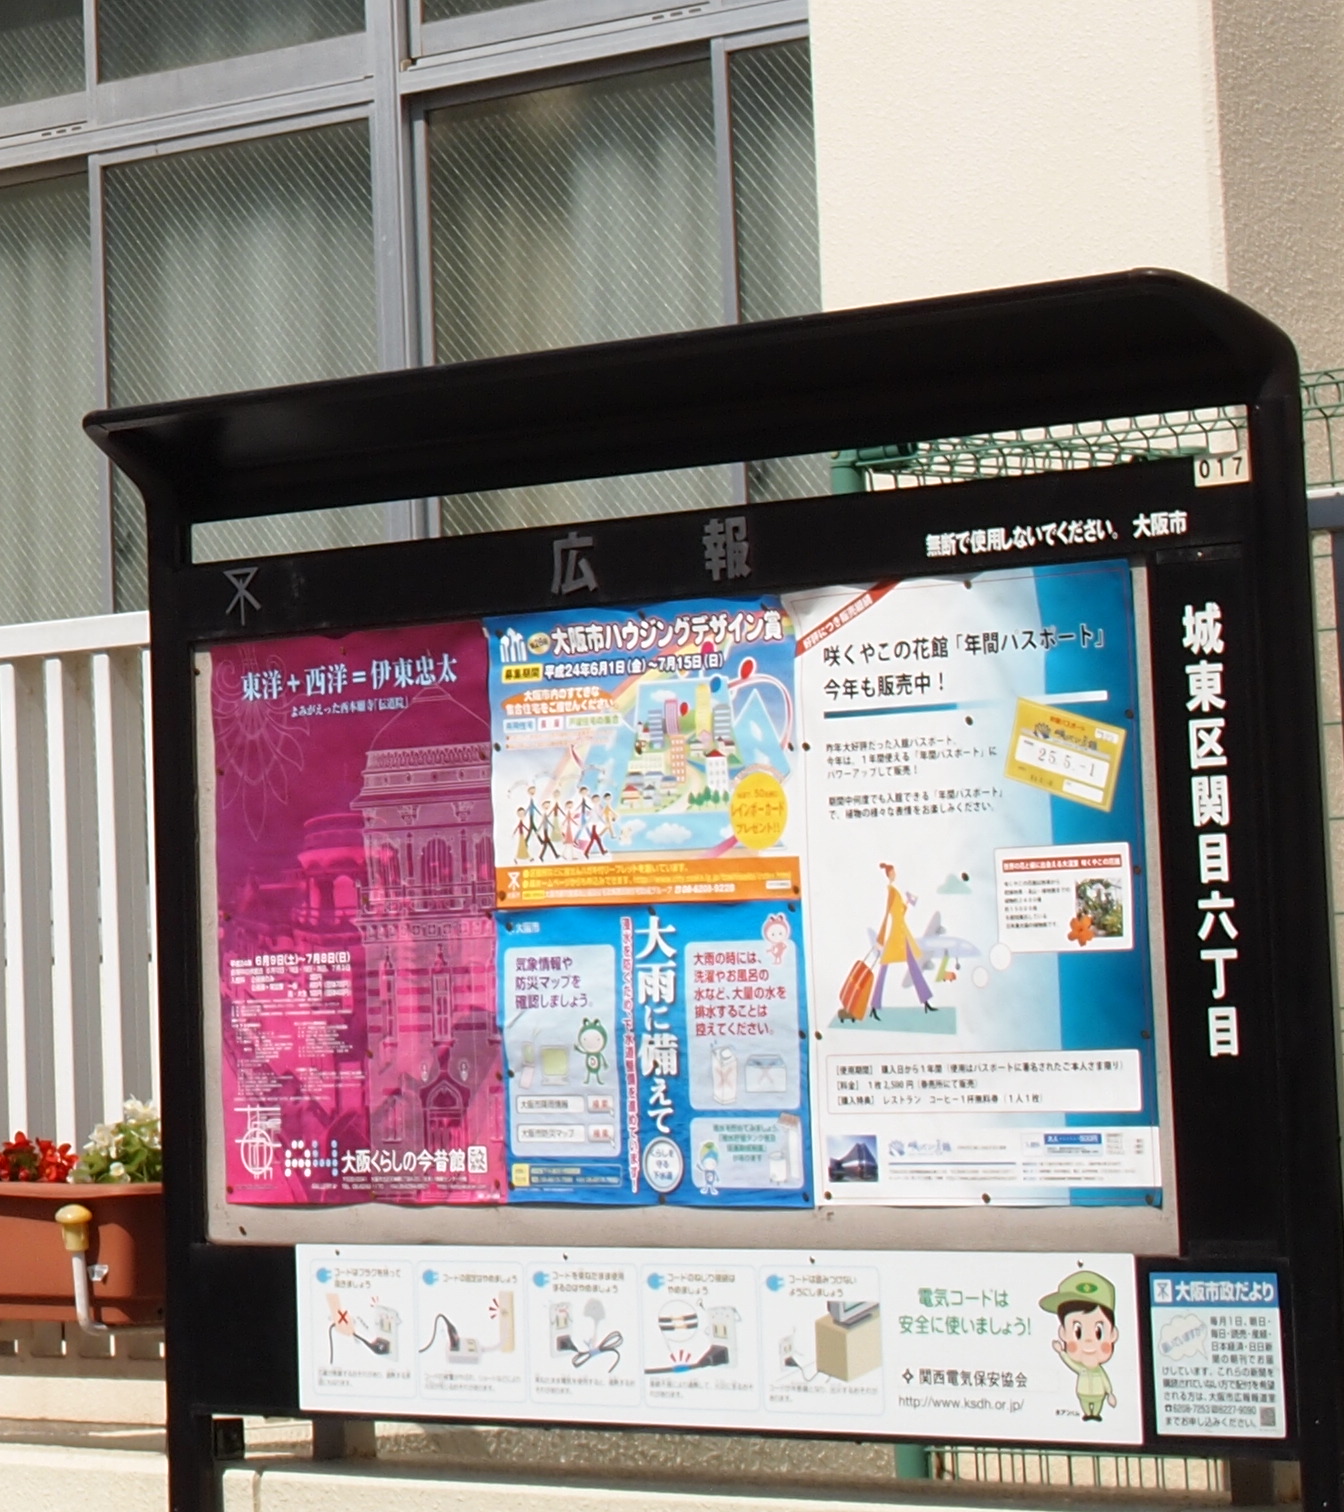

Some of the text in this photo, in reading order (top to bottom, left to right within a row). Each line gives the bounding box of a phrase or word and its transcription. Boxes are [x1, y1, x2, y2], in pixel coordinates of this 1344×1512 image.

[1199, 457, 1242, 478] 017
[926, 510, 1187, 557] 無断で使用しないでください。 大阪市
[551, 610, 783, 656] 大阪市ハウジングデザイン賞
[823, 624, 1104, 667] 咲くやこの花館「年間パスポート」
[1182, 602, 1239, 1057] 城東区関目六丁目
[516, 956, 572, 971] 気象情報や
[515, 975, 581, 990] 防災マップを
[515, 993, 592, 1008] 確認しましょう。
[694, 987, 786, 1001] 水など、大量の水を
[695, 1005, 767, 1018] 排水することは
[635, 915, 678, 1134] 大雨に備えて
[341, 1149, 465, 1173] 大阪くらしの今昔館
[918, 1288, 1009, 1308] 電気コードは
[1175, 1281, 1274, 1302] 大阪市政だより
[898, 1315, 1032, 1336] 安全に使いましょう!
[919, 1368, 1028, 1388] 関西電気保安協会
[898, 1395, 1024, 1413] http://www.ksdh.or.jp/
